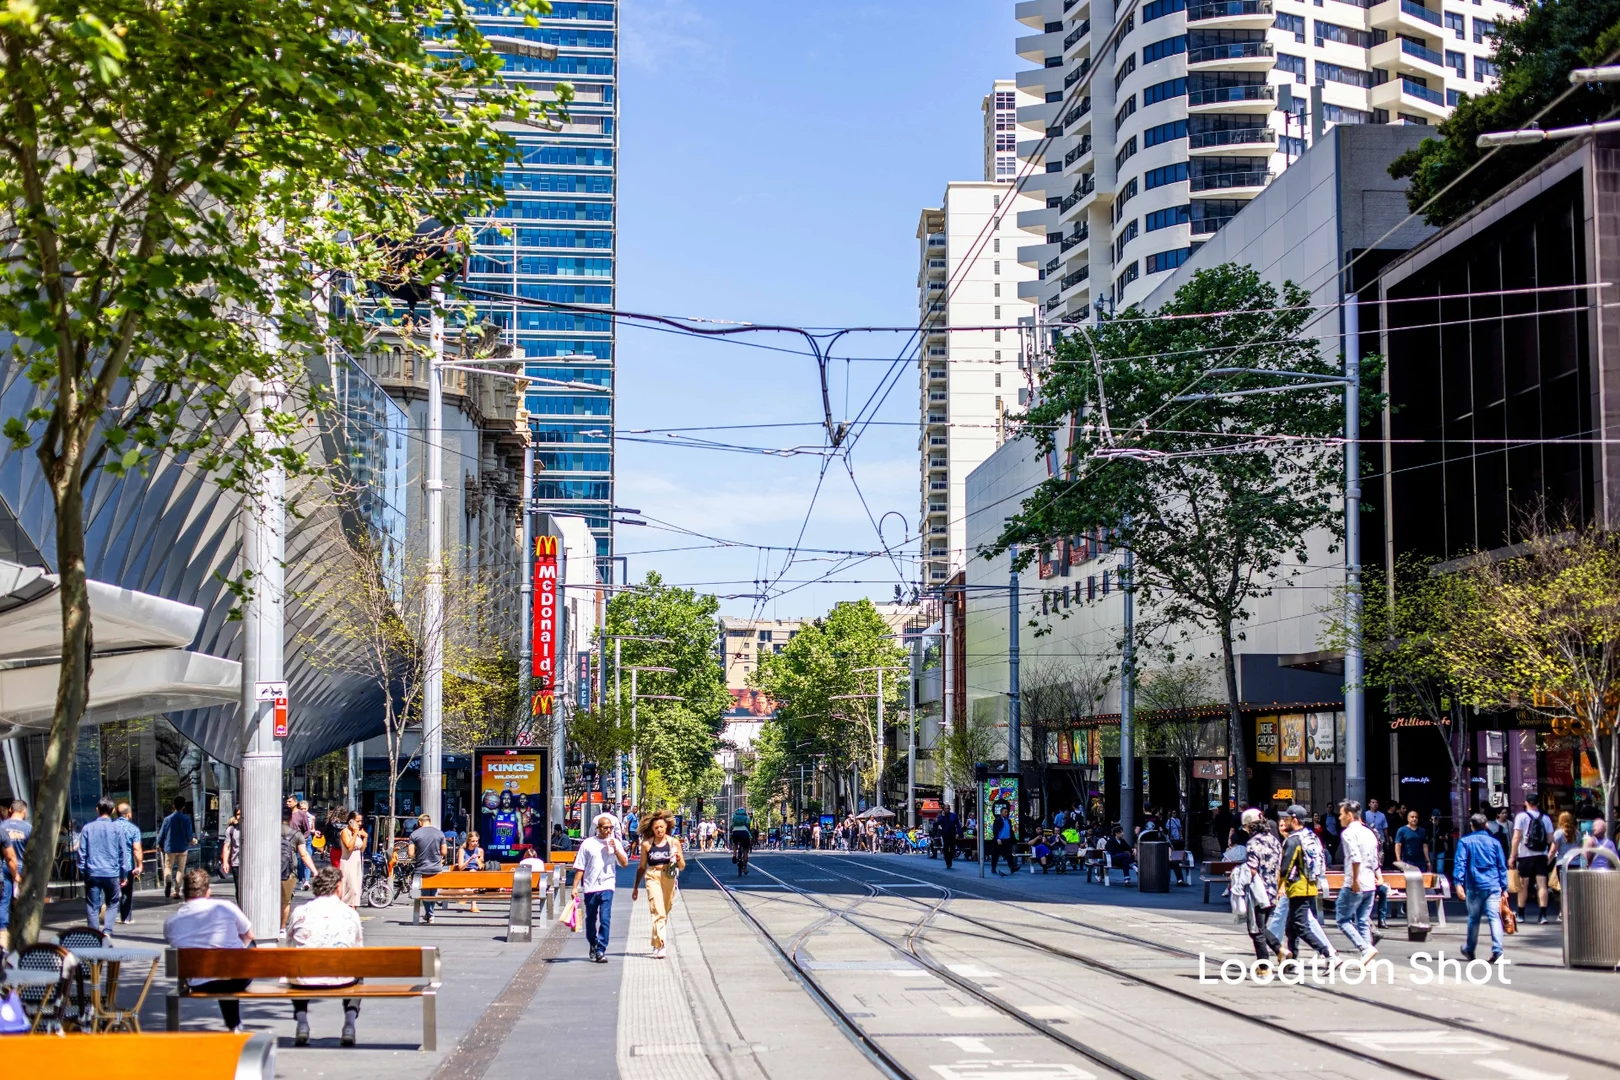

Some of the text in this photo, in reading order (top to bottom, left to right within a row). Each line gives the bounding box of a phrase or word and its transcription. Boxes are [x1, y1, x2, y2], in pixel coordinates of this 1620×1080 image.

[538, 565, 556, 686] McDonald's
[1390, 716, 1431, 729] Million
[487, 763, 535, 772] KINGS
